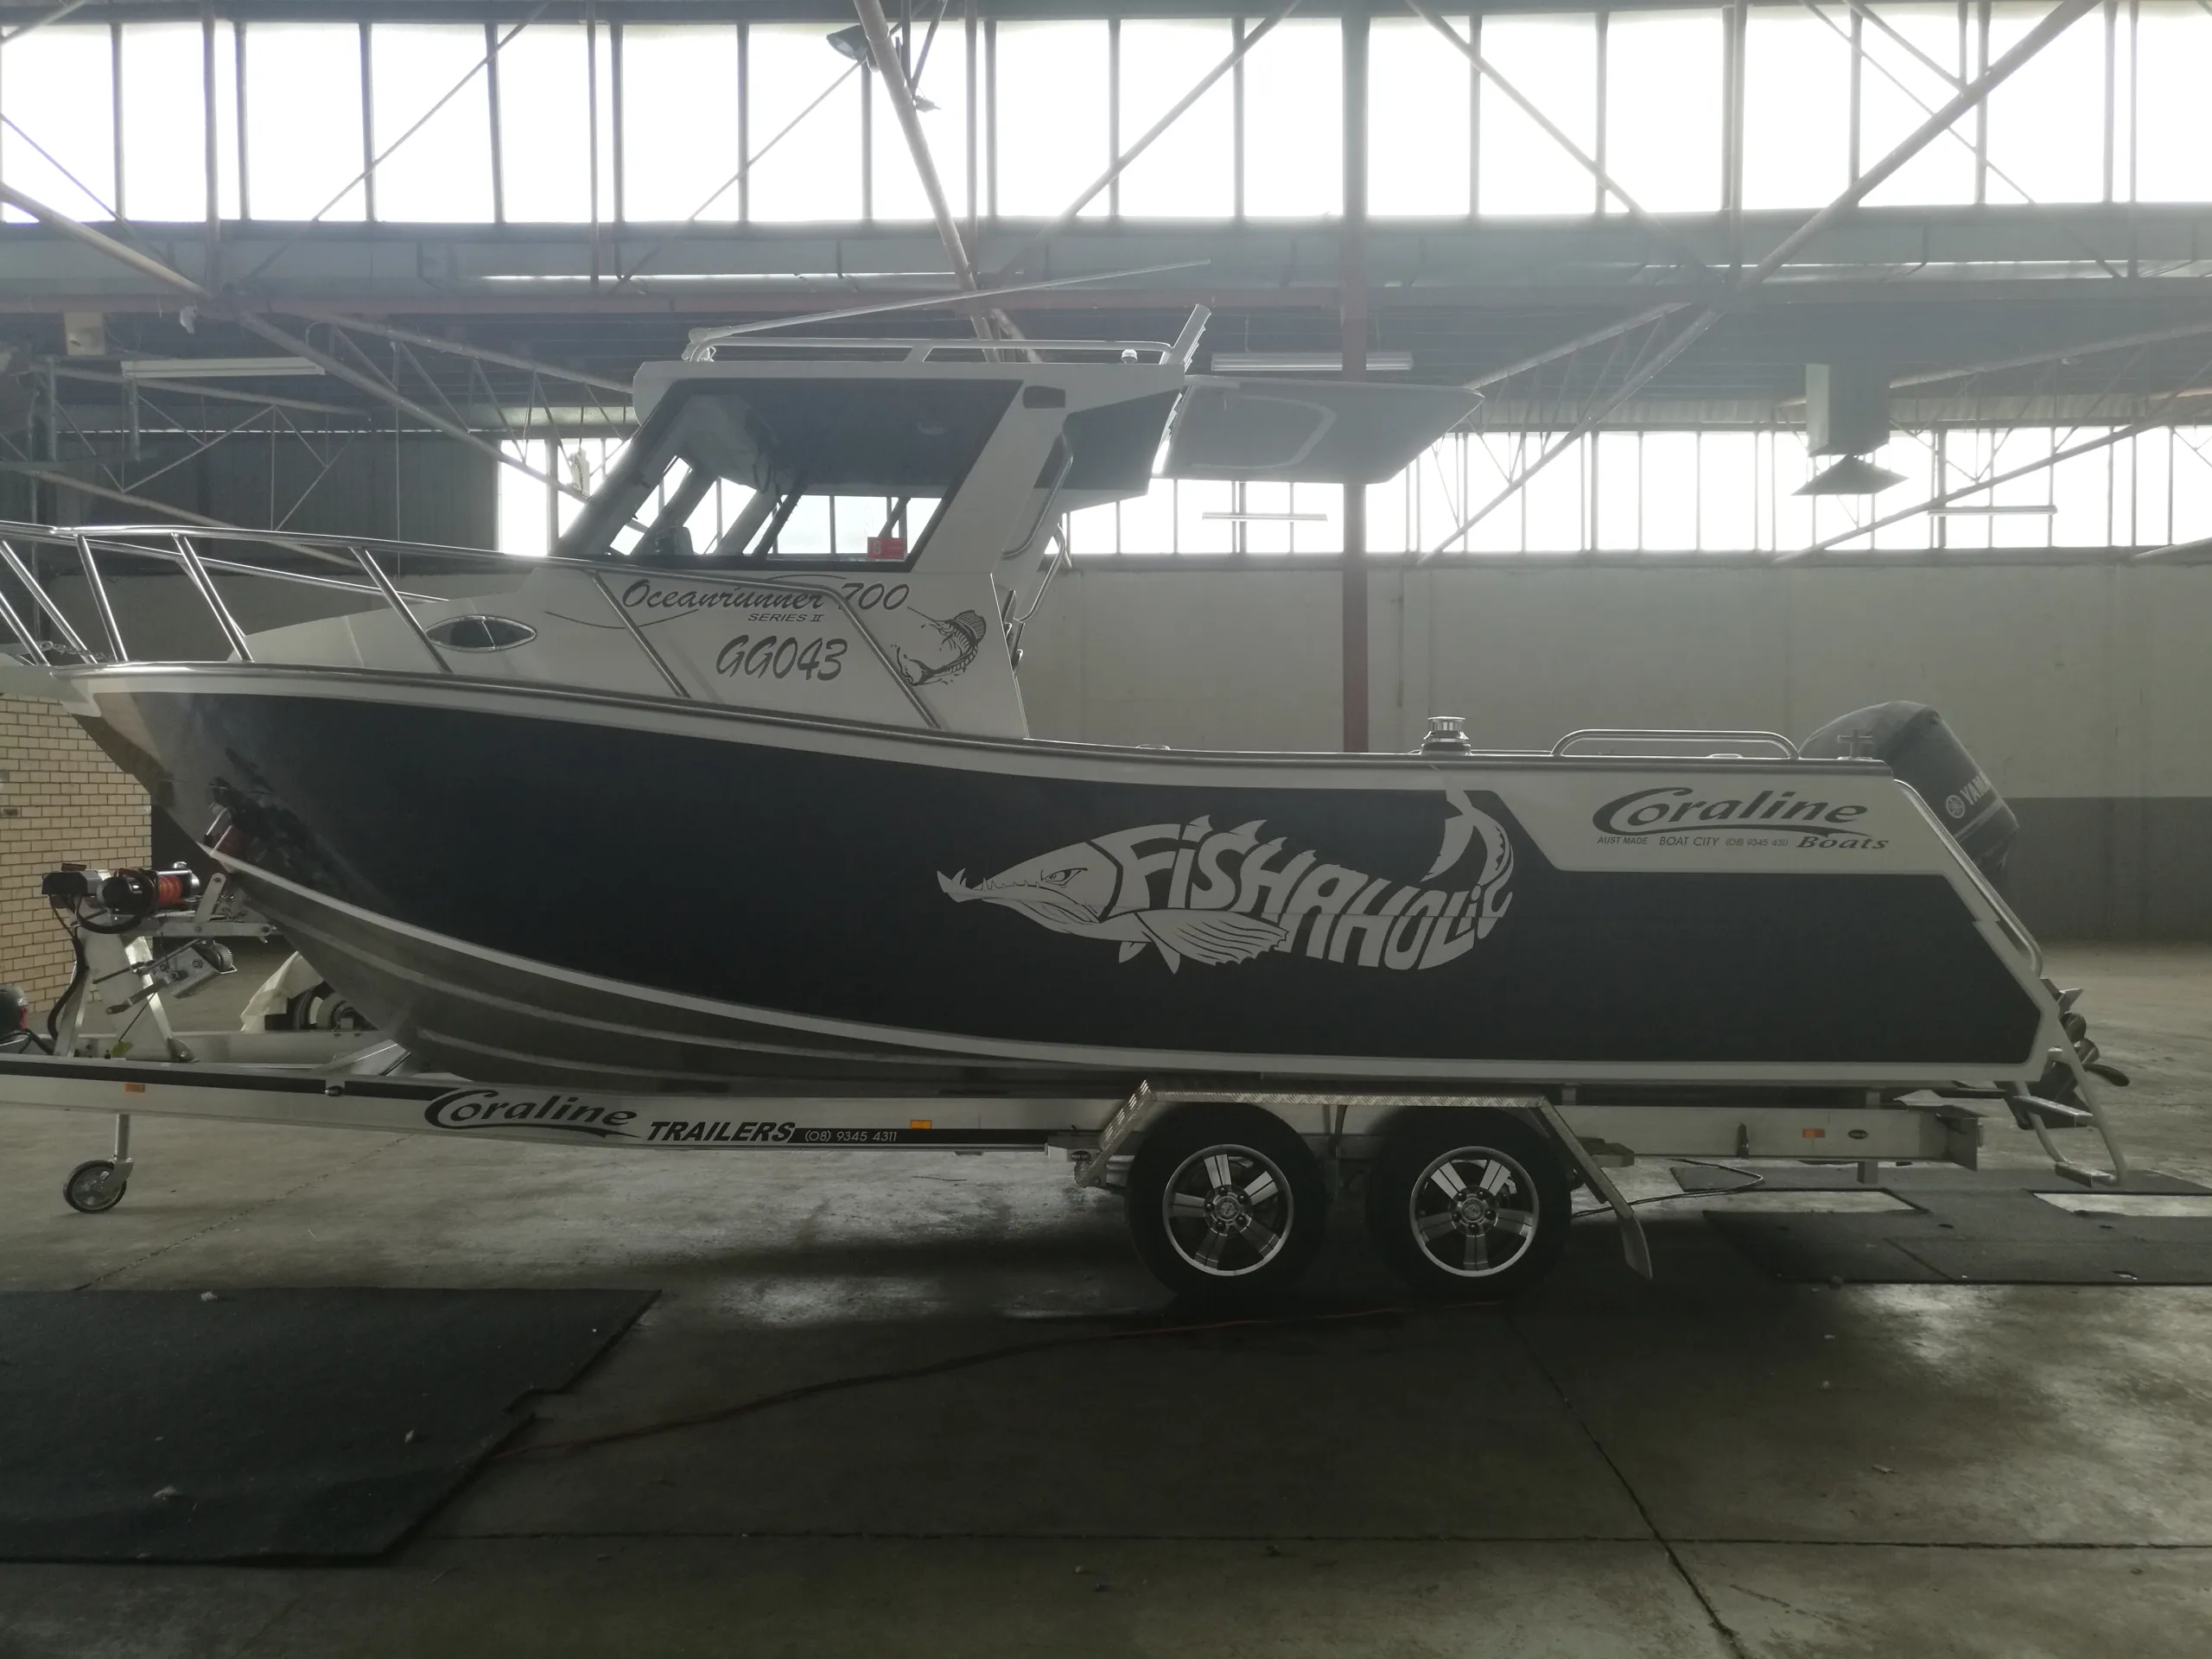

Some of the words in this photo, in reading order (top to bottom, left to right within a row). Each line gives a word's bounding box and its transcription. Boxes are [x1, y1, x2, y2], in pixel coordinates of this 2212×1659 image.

[621, 579, 825, 610] Oceanrunner
[838, 582, 910, 610] 700
[747, 612, 807, 623] SERIES
[809, 613, 824, 622] II
[1592, 787, 1869, 836] Coraline
[1597, 836, 1622, 845] AUST
[1623, 836, 1649, 845] MADE
[1659, 836, 1689, 846] BOAT
[1693, 836, 1719, 847] CITY
[1726, 837, 1744, 848] (08)
[1747, 837, 1769, 847] 9345
[1796, 836, 1890, 849] Boats
[424, 1090, 641, 1138] Coraline
[645, 1122, 796, 1142] TRAILERS
[804, 1129, 831, 1142] (08)
[836, 1130, 868, 1141] 9345
[872, 1130, 897, 1141] 4311
